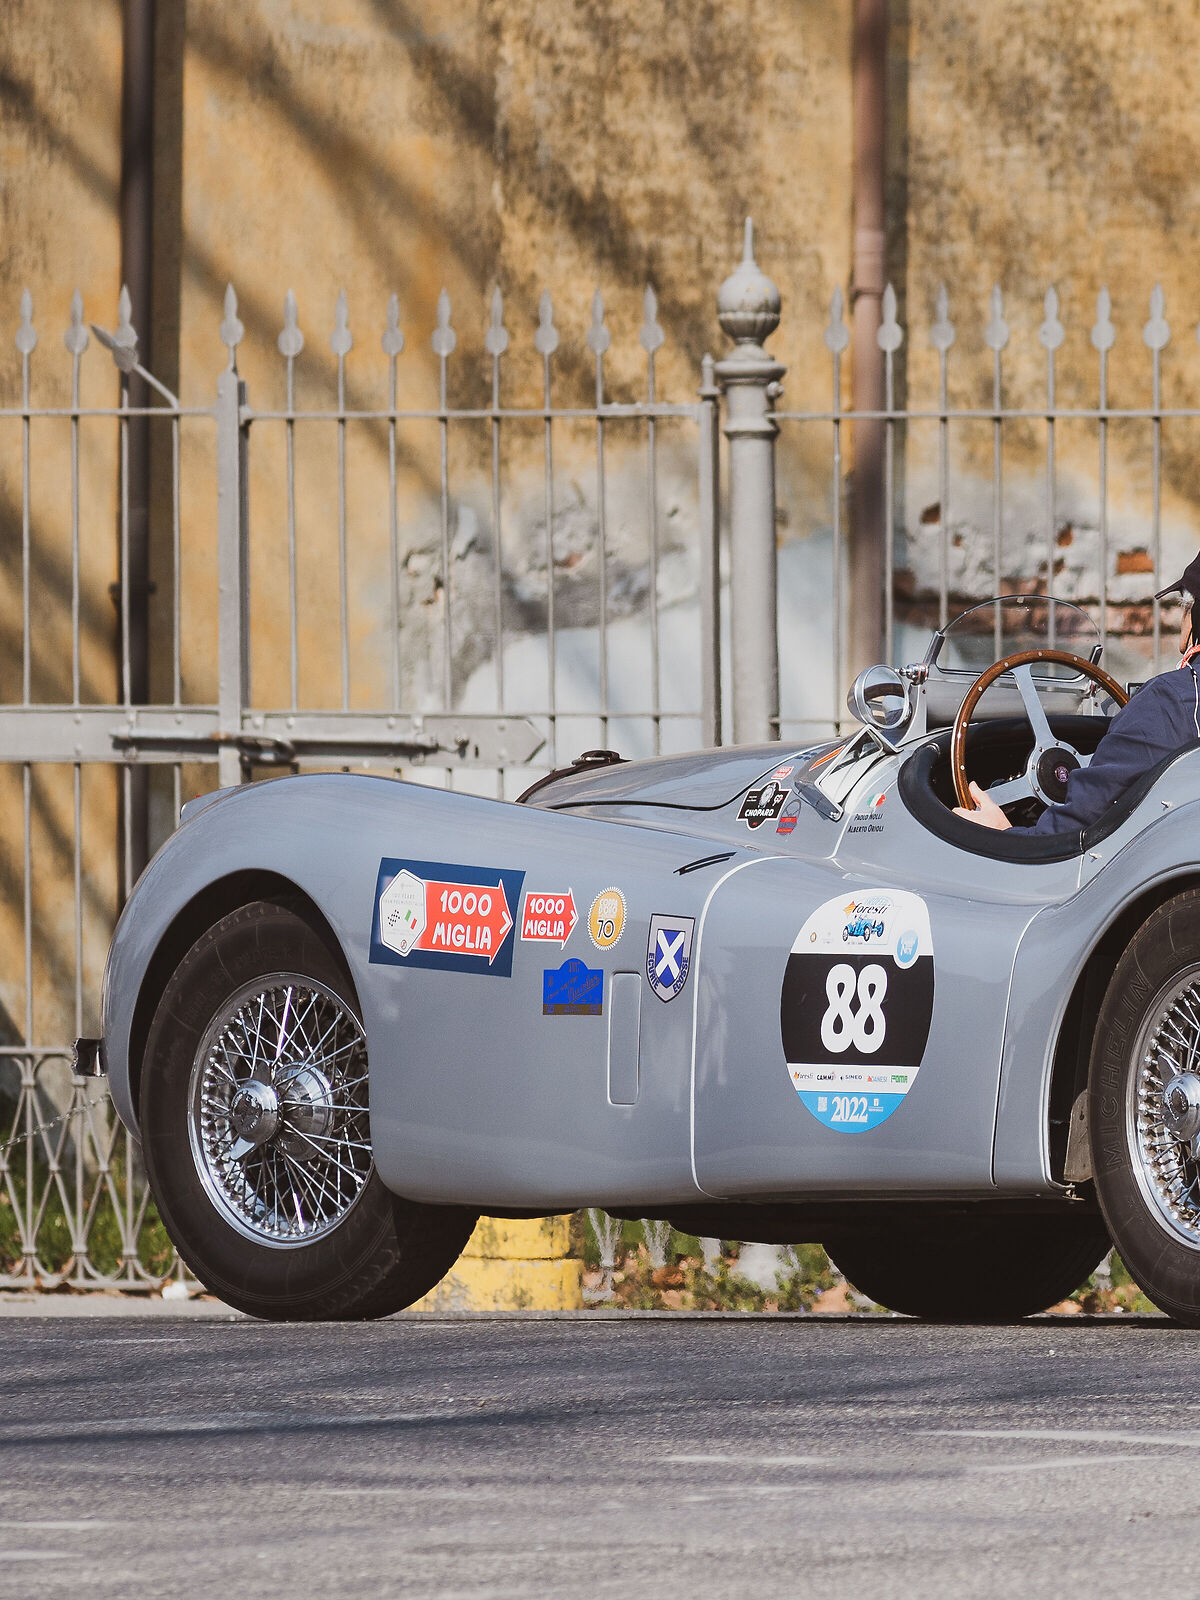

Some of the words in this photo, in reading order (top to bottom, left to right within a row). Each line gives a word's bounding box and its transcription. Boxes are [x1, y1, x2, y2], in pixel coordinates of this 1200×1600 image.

[744, 808, 774, 817] CHOPARD
[440, 889, 492, 917] 1000
[529, 897, 565, 915] 1000
[432, 922, 492, 950] MIGLIA
[524, 919, 565, 937] MIGLIA
[597, 918, 615, 939] 70
[648, 952, 660, 990] ECURIE
[672, 957, 689, 994] ECOSSE
[820, 963, 888, 1054] 88
[1101, 973, 1150, 1170] MICHELIN
[830, 1096, 868, 1123] 2022
